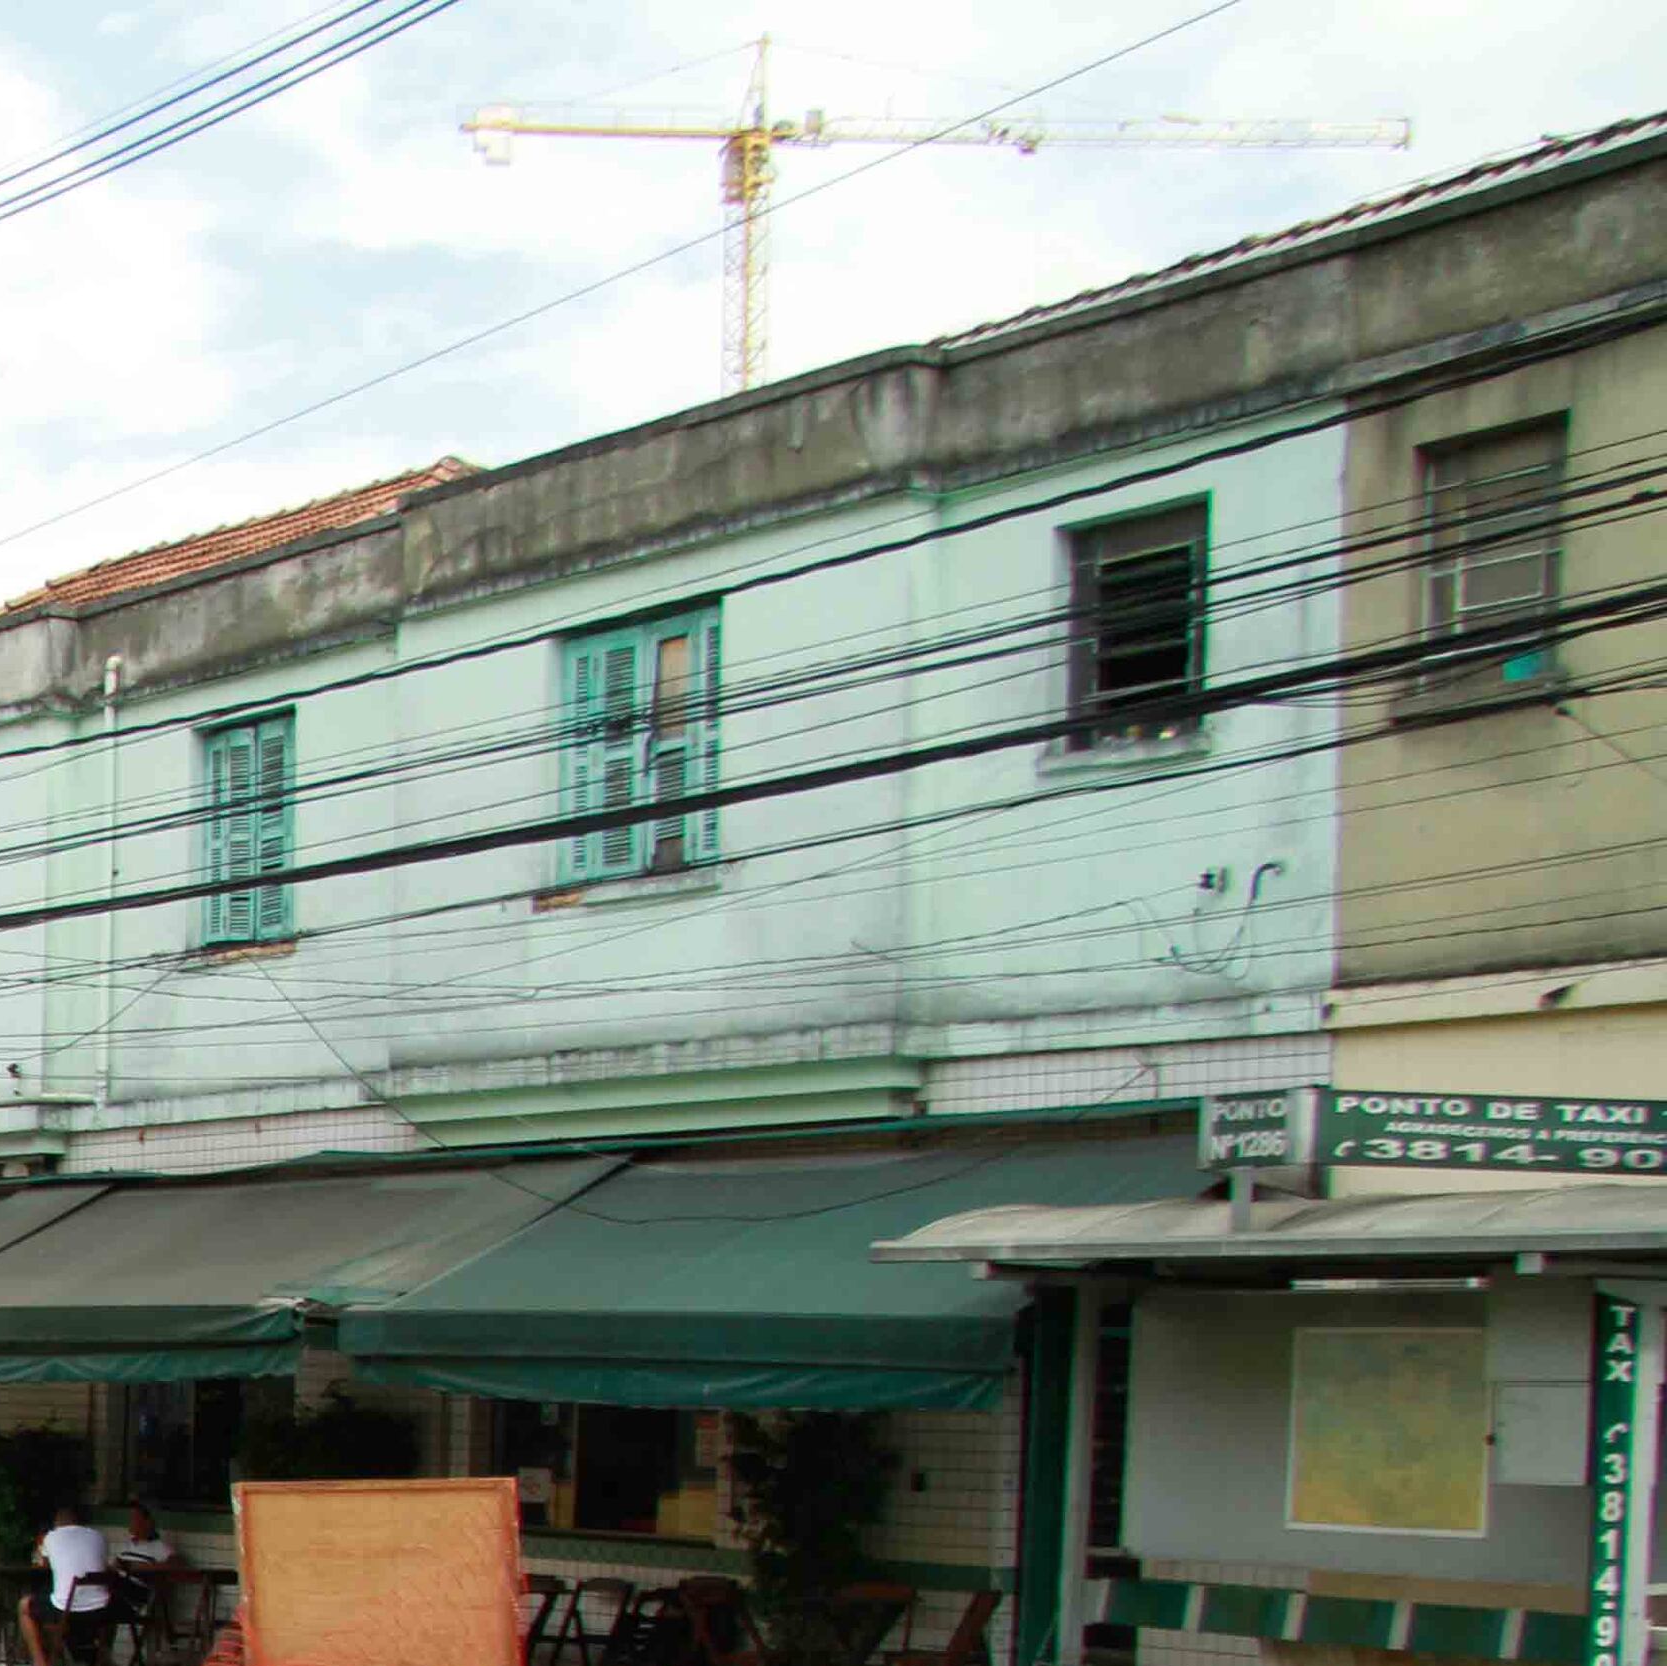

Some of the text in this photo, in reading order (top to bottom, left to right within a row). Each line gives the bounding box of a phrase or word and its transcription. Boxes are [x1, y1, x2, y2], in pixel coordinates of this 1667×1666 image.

[1210, 1098, 1287, 1121] PONTO
[1335, 1095, 1471, 1117] PONTO
[1486, 1101, 1542, 1121] DE
[1555, 1103, 1649, 1124] TAXI
